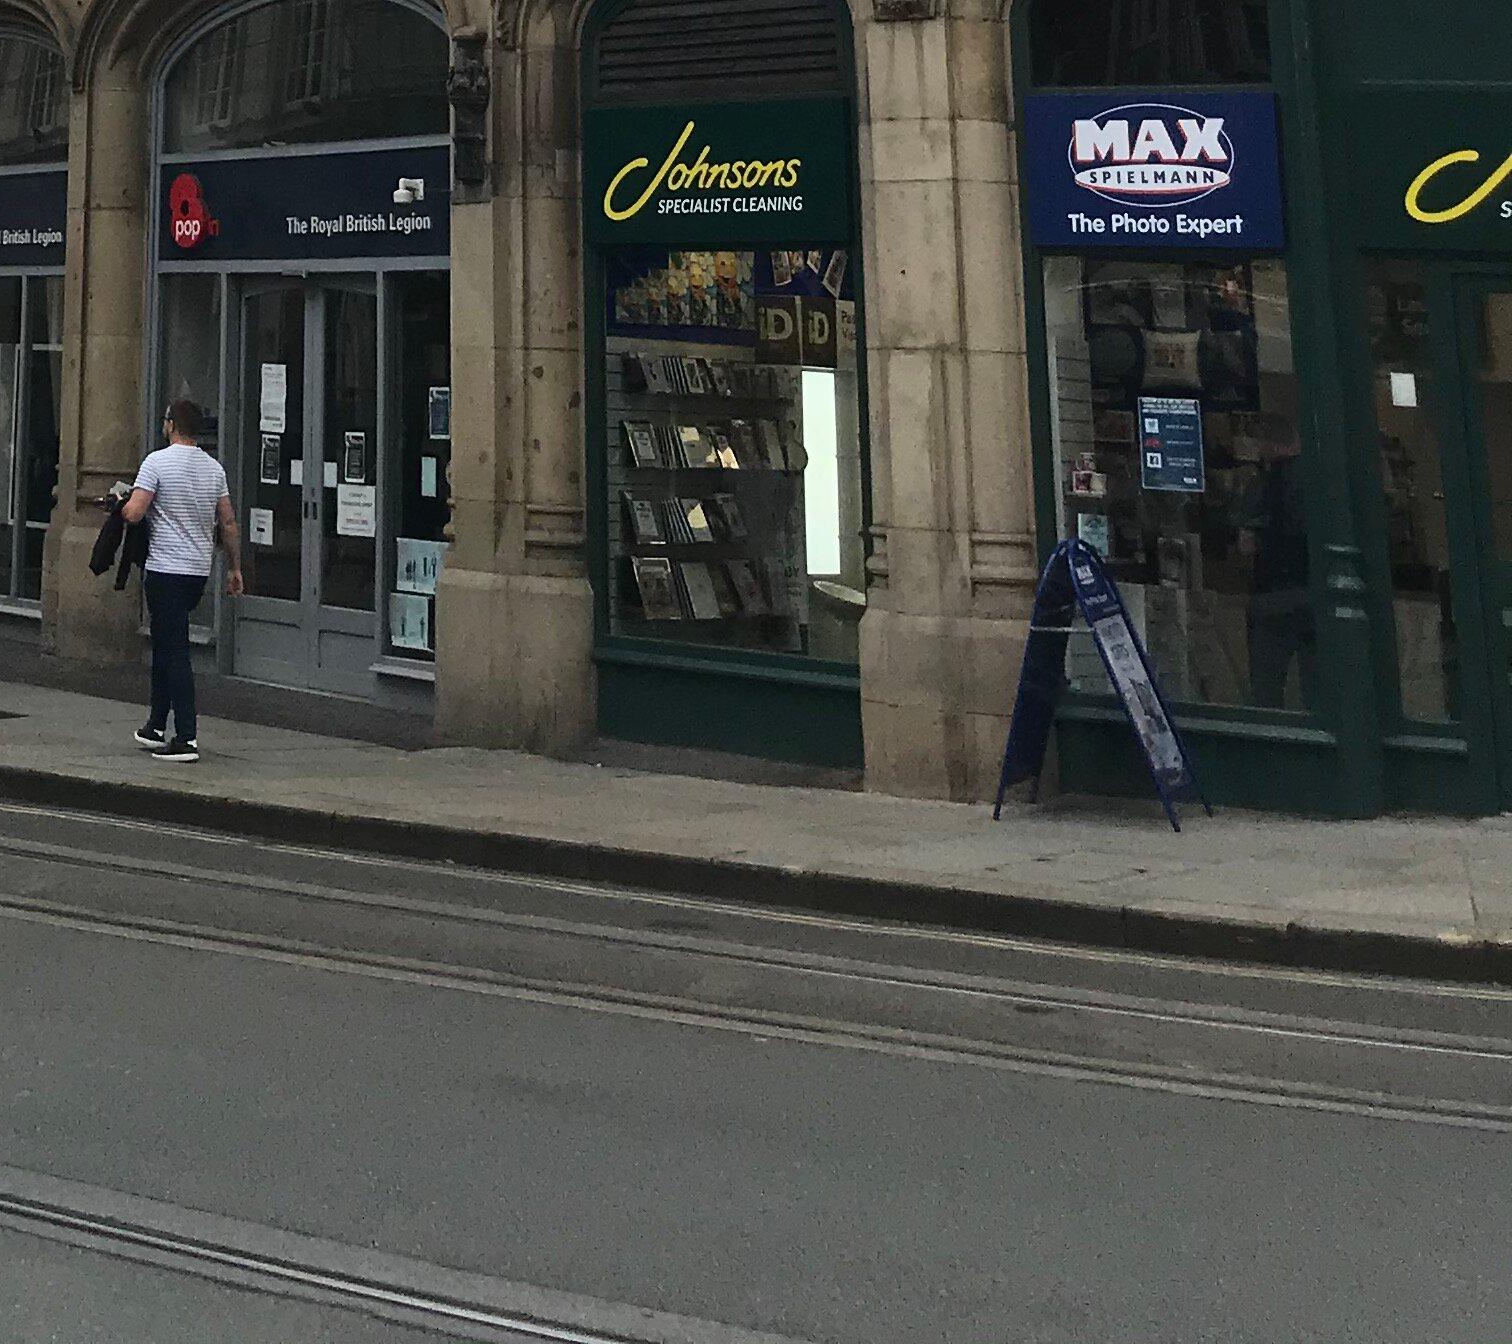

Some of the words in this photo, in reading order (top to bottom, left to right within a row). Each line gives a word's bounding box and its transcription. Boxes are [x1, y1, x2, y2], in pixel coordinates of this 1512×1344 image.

[1071, 117, 1228, 163] MAX
[603, 120, 801, 221] Johnsons
[1089, 170, 1215, 184] SPIELMANN
[657, 197, 730, 214] SPECIALIST
[732, 196, 803, 212] CLEANING
[176, 218, 201, 241] pop
[286, 216, 308, 234] The
[310, 215, 343, 237] Royal
[346, 214, 386, 233] British
[389, 212, 432, 235] Legion
[1067, 213, 1106, 234] The
[1111, 213, 1170, 234] Photo
[1176, 214, 1244, 239] Expert
[2, 229, 31, 245] British
[32, 228, 63, 248] Legion
